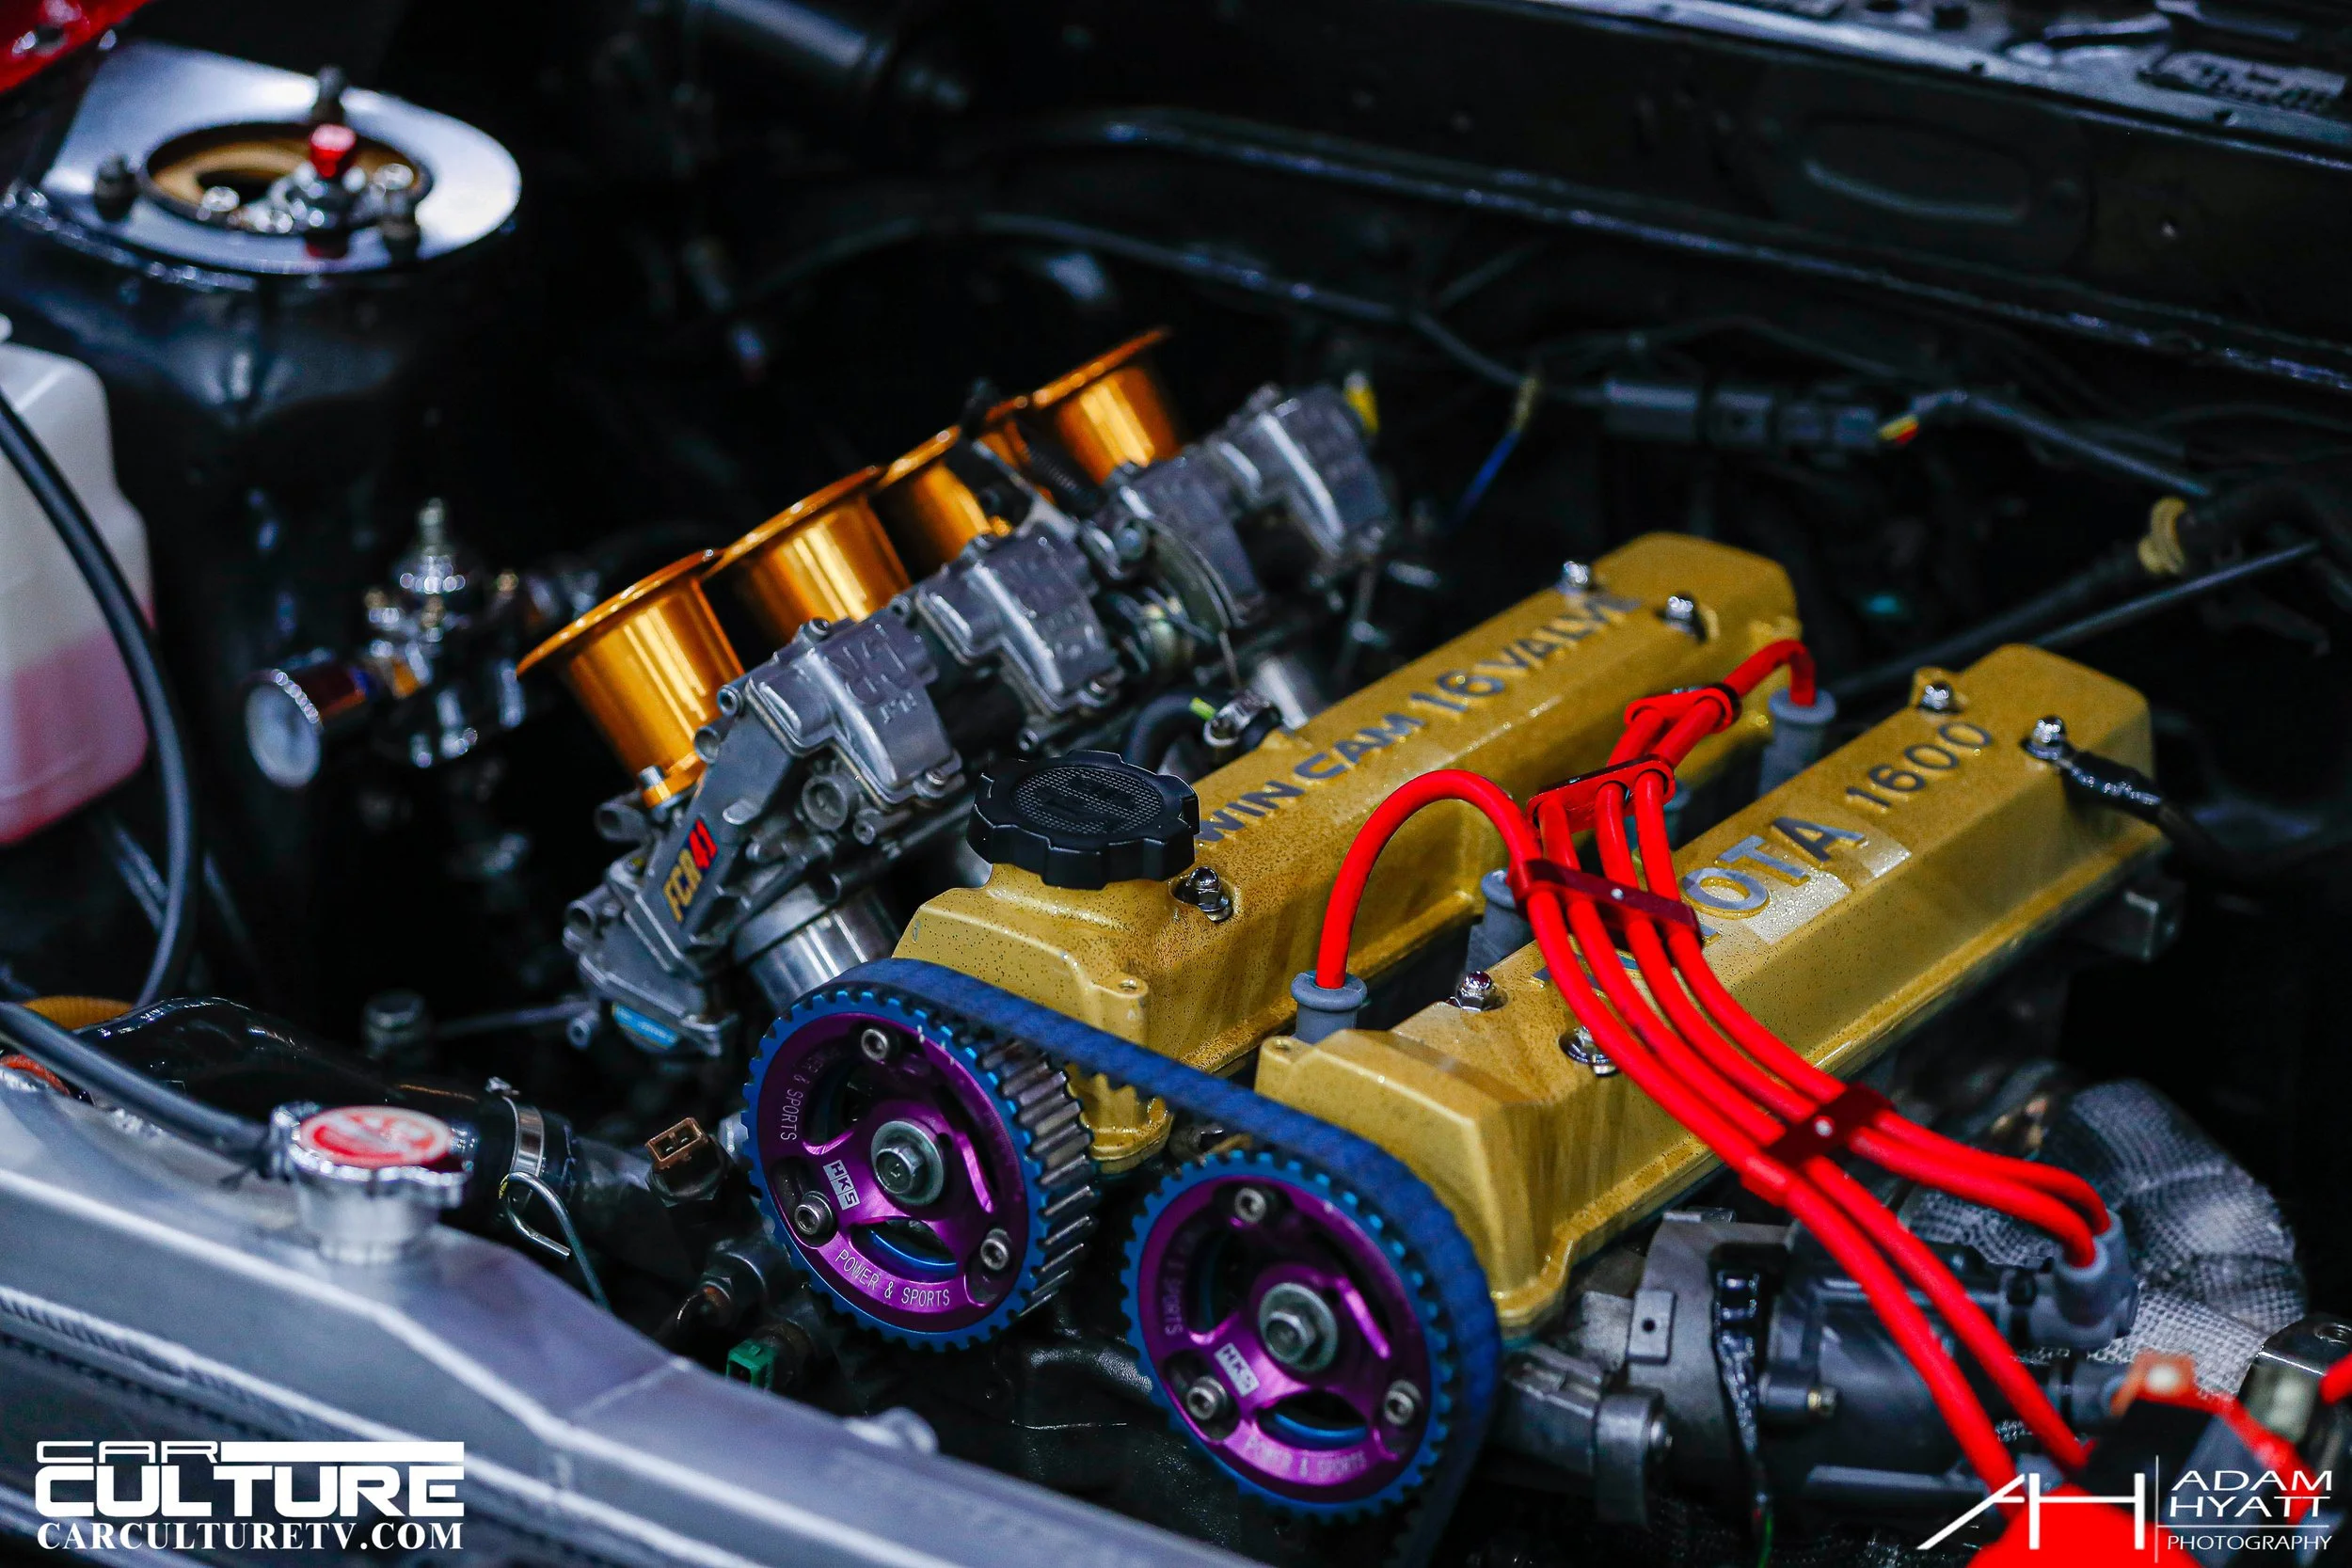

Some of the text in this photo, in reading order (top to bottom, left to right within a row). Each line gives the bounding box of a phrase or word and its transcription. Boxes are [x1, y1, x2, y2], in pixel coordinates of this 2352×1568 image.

[1195, 779, 1305, 848] WIN
[1294, 712, 1425, 780] CAM
[1410, 669, 1505, 715] 16
[1845, 721, 1993, 808] 1600
[780, 1087, 804, 1142] SPORTS
[828, 1161, 858, 1207] HKS
[835, 1249, 950, 1307] POWER & SPORTS
